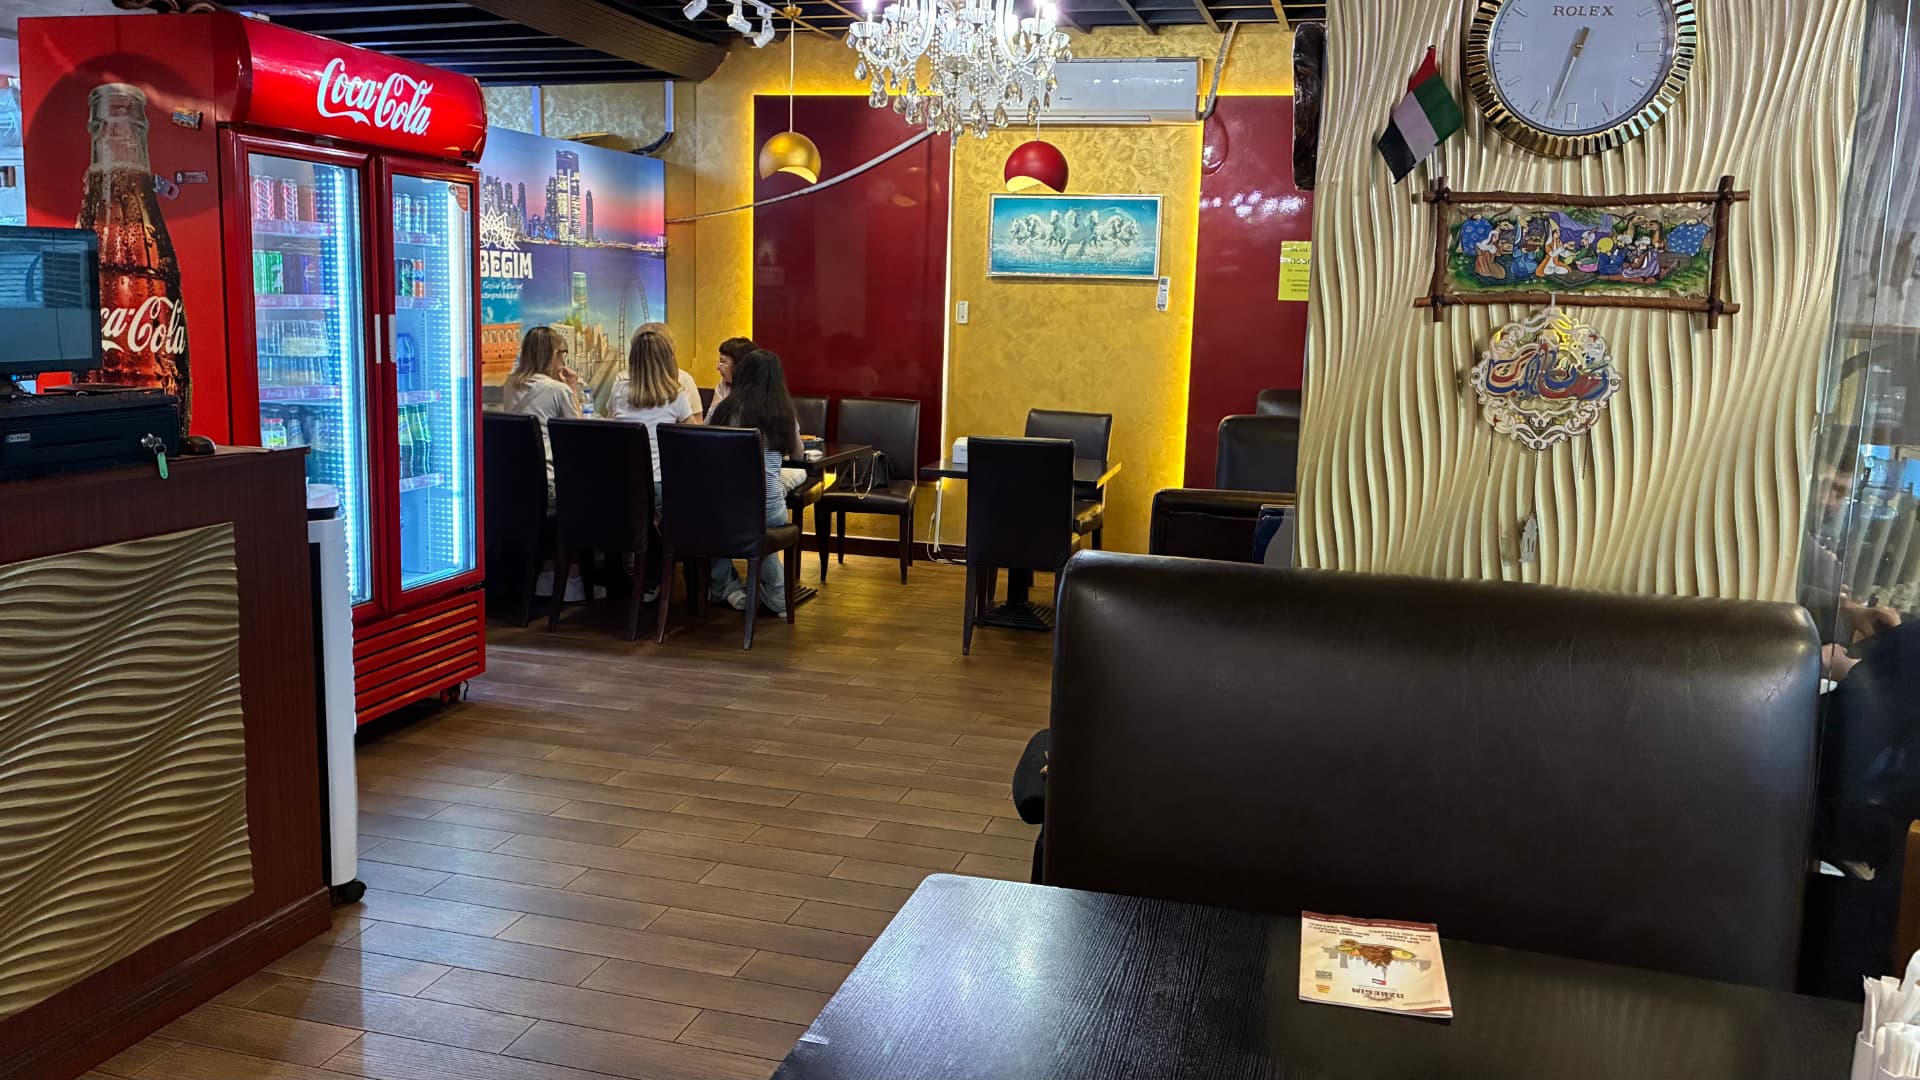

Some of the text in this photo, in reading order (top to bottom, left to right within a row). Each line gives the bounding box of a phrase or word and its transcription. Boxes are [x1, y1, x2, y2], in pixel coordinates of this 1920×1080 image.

[1552, 5, 1614, 16] ROLEX
[317, 57, 434, 135] Coca-Cola
[480, 249, 533, 279] BEGIM
[100, 296, 186, 354] ca-Cola
